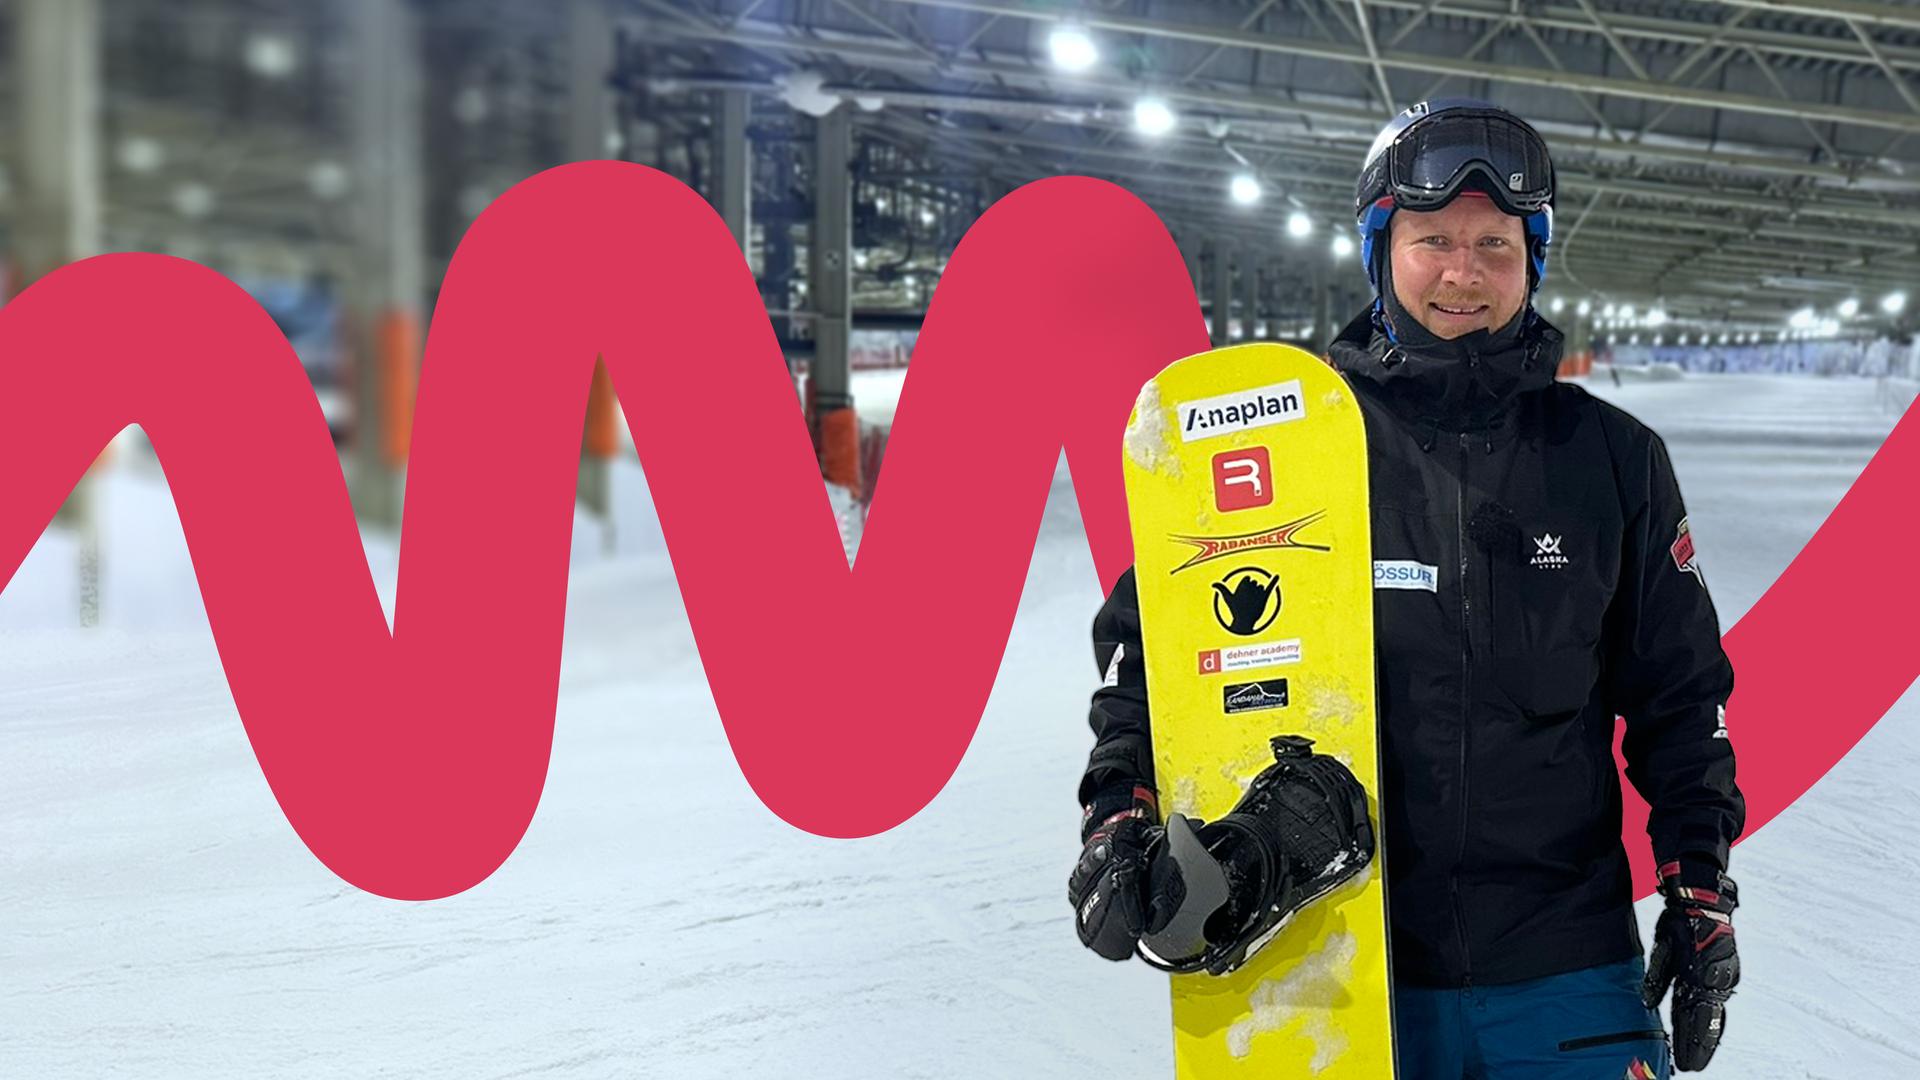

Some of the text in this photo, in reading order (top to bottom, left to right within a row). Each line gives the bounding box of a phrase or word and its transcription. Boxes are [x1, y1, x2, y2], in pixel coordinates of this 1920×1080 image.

[1185, 393, 1299, 432] Anaplan
[1196, 526, 1295, 557] RABANSER
[1530, 555, 1569, 565] ALASKA
[1374, 563, 1432, 583] ÖSSUR
[1226, 643, 1300, 660] dehner academy
